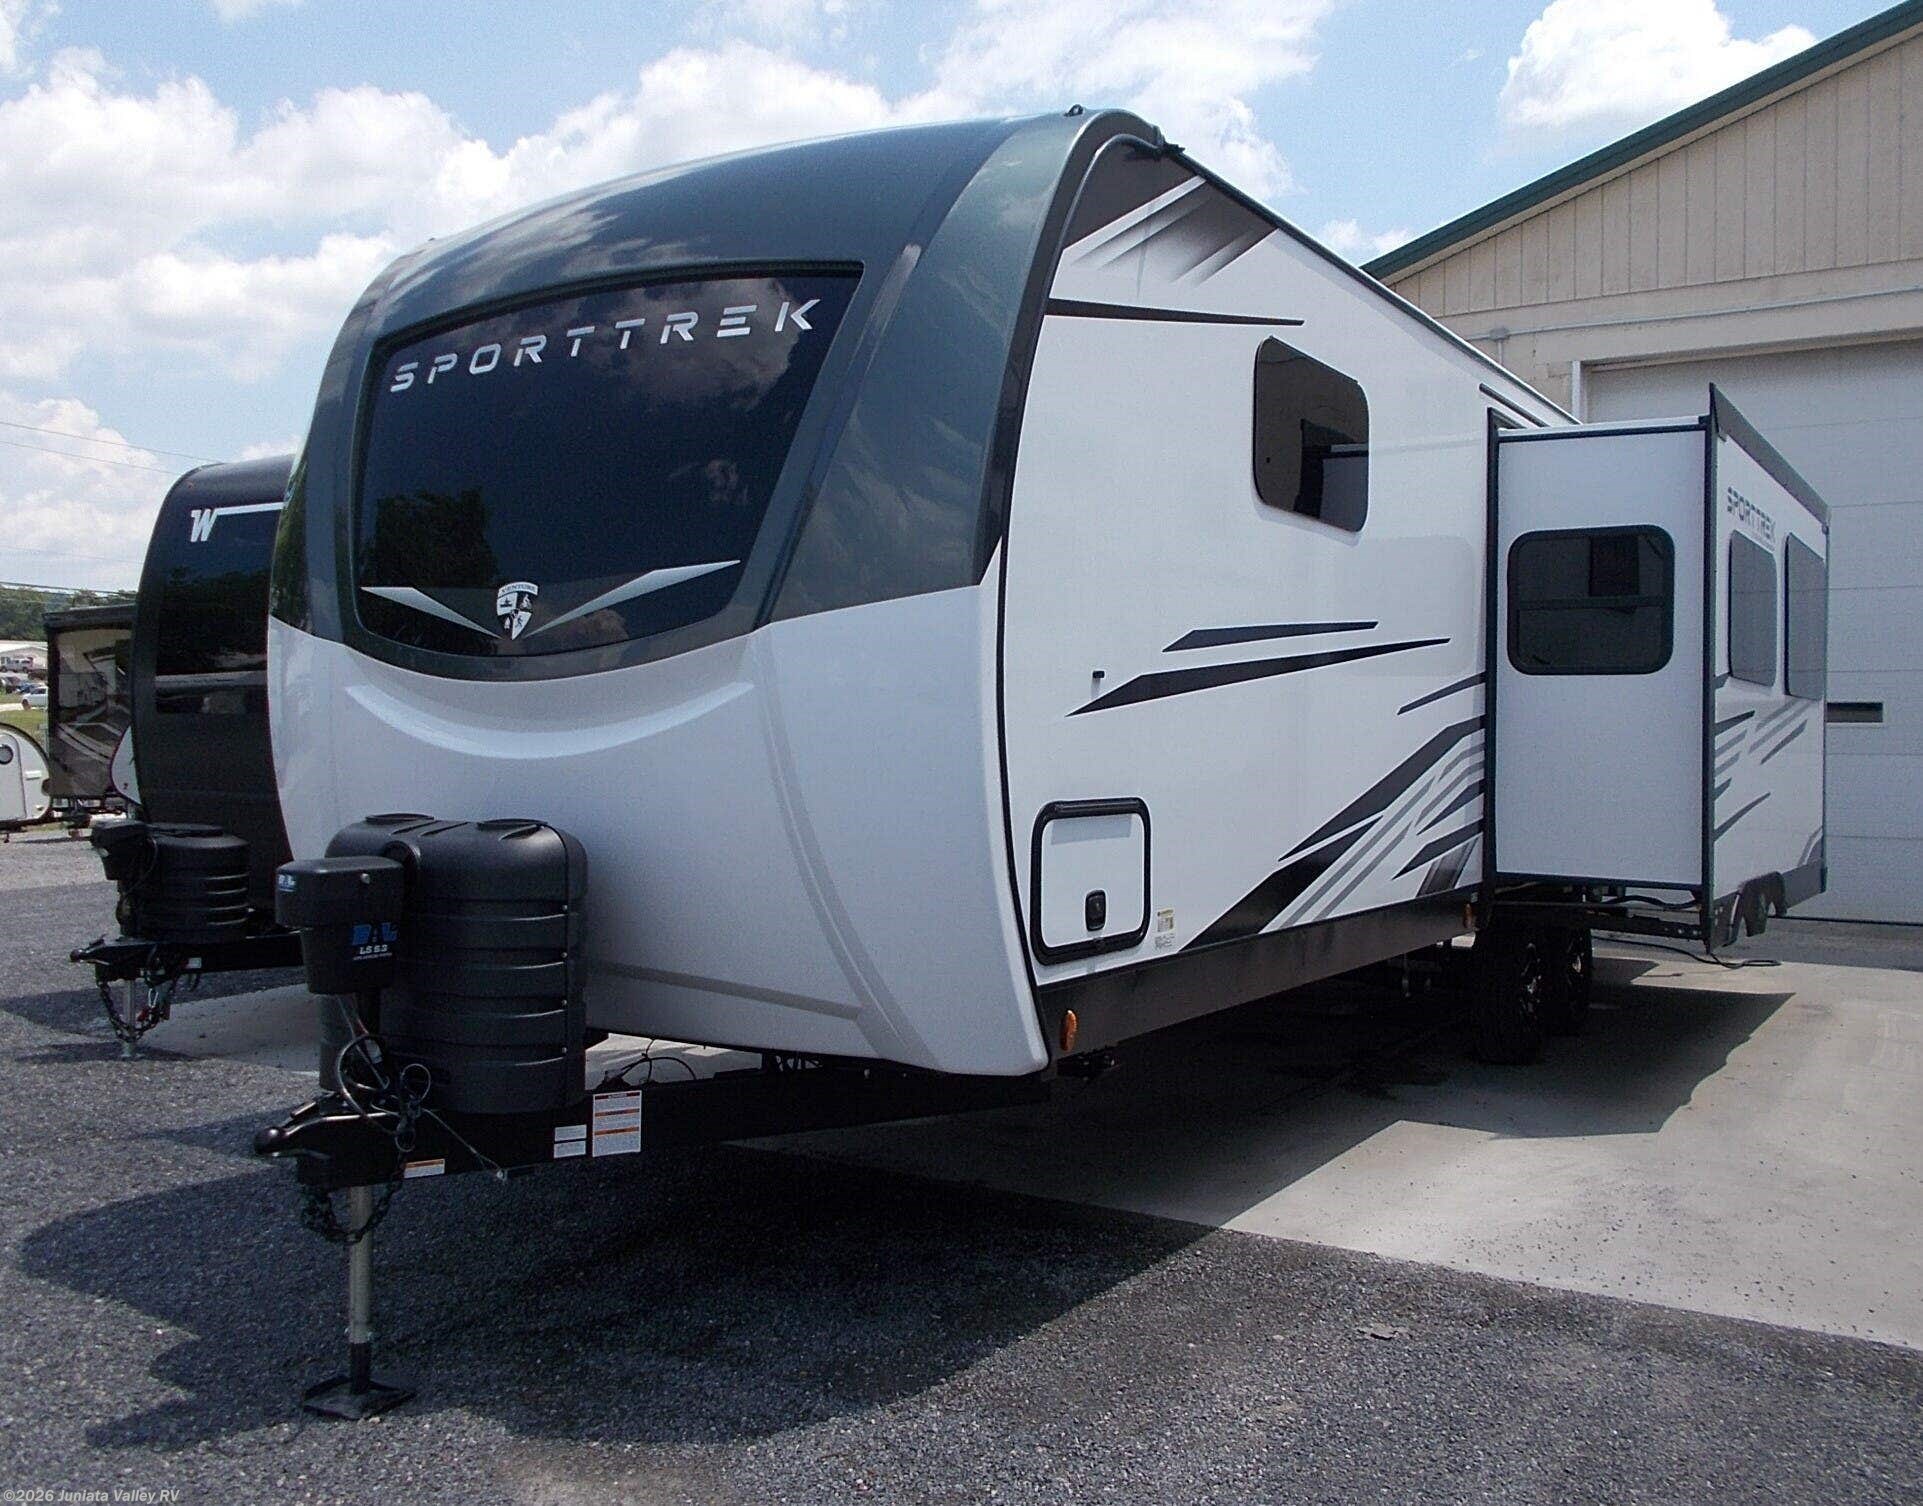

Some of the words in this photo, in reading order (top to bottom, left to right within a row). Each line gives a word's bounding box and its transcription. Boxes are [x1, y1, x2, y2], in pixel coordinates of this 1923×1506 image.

[390, 298, 821, 393] SPORTTREK
[190, 508, 219, 542] W
[1727, 486, 1776, 545] SPORTTREK
